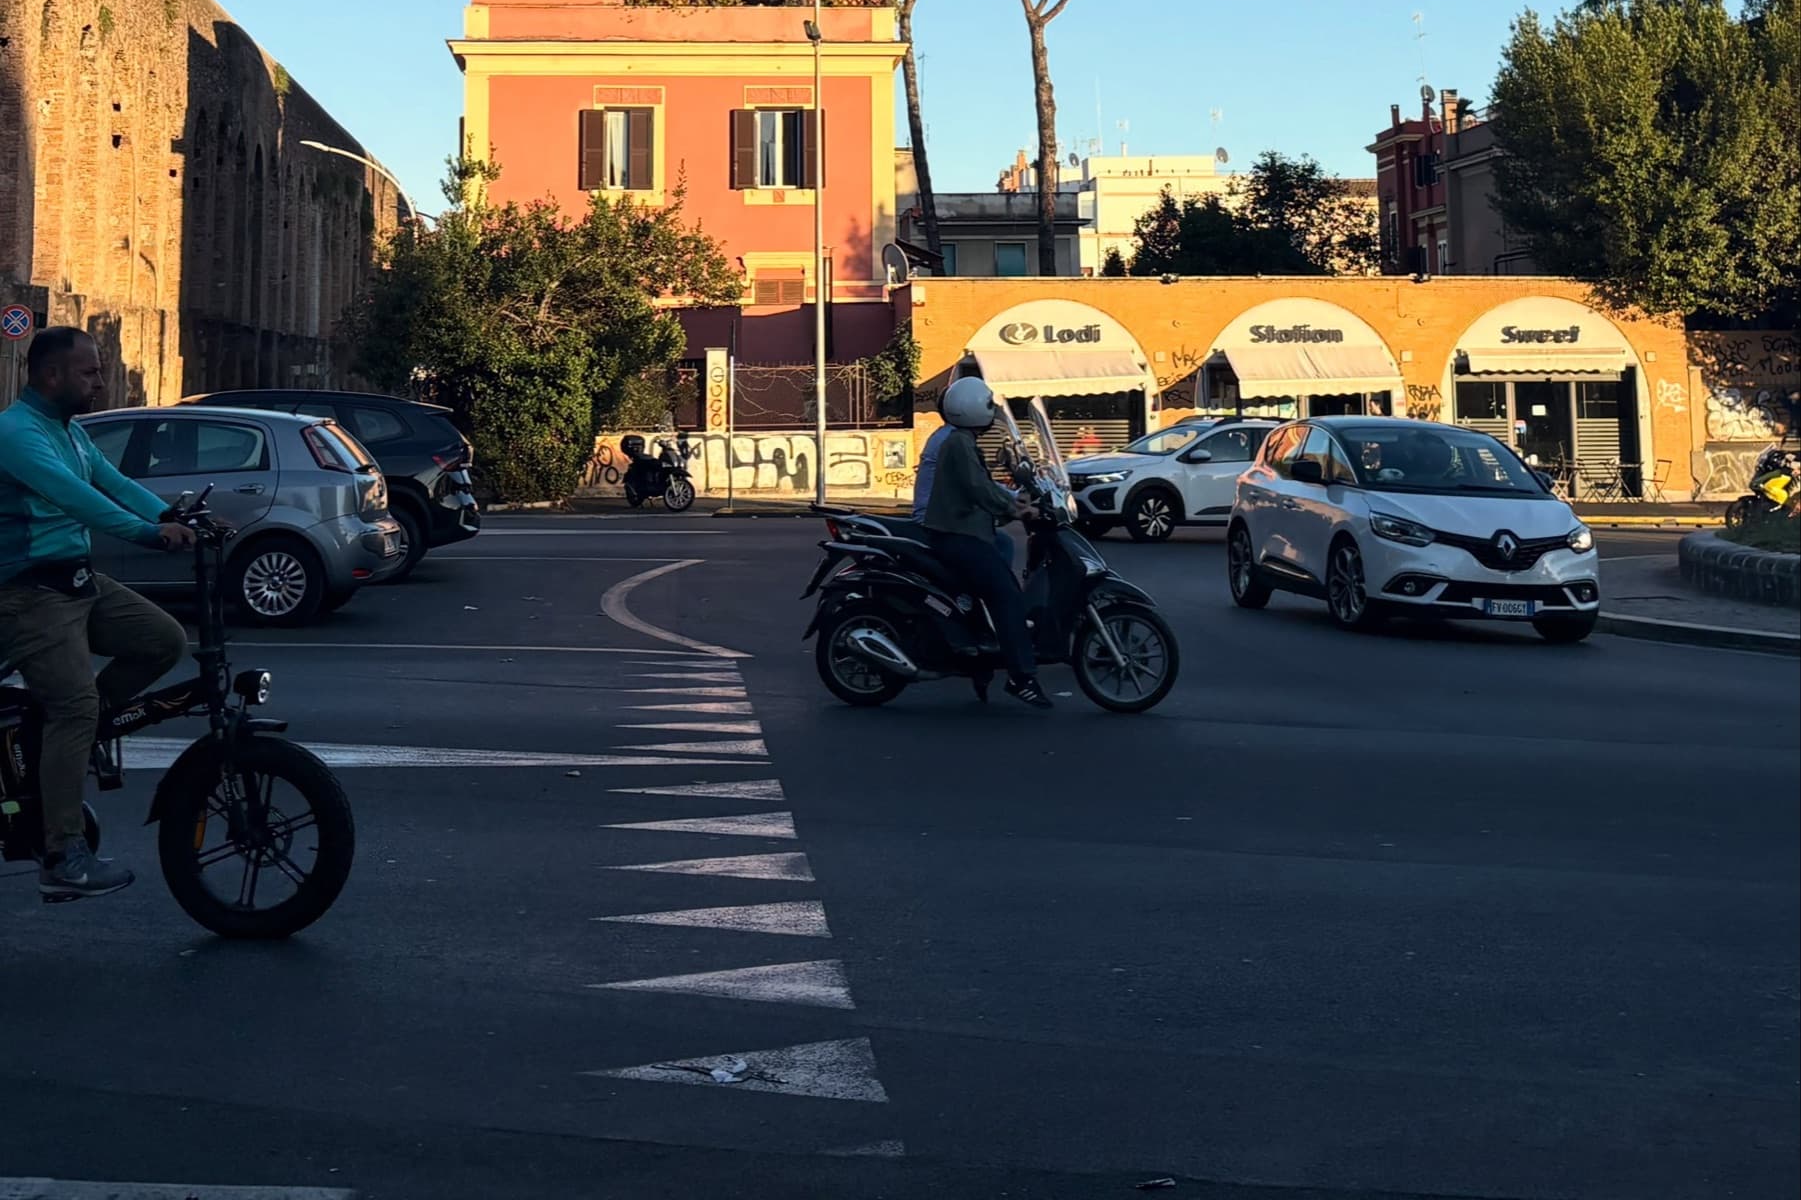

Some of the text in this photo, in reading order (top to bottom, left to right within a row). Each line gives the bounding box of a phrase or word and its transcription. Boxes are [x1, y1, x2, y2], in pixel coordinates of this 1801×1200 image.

[1043, 324, 1101, 343] Lodi
[1249, 324, 1343, 343] Station
[1500, 325, 1580, 343] Sweet
